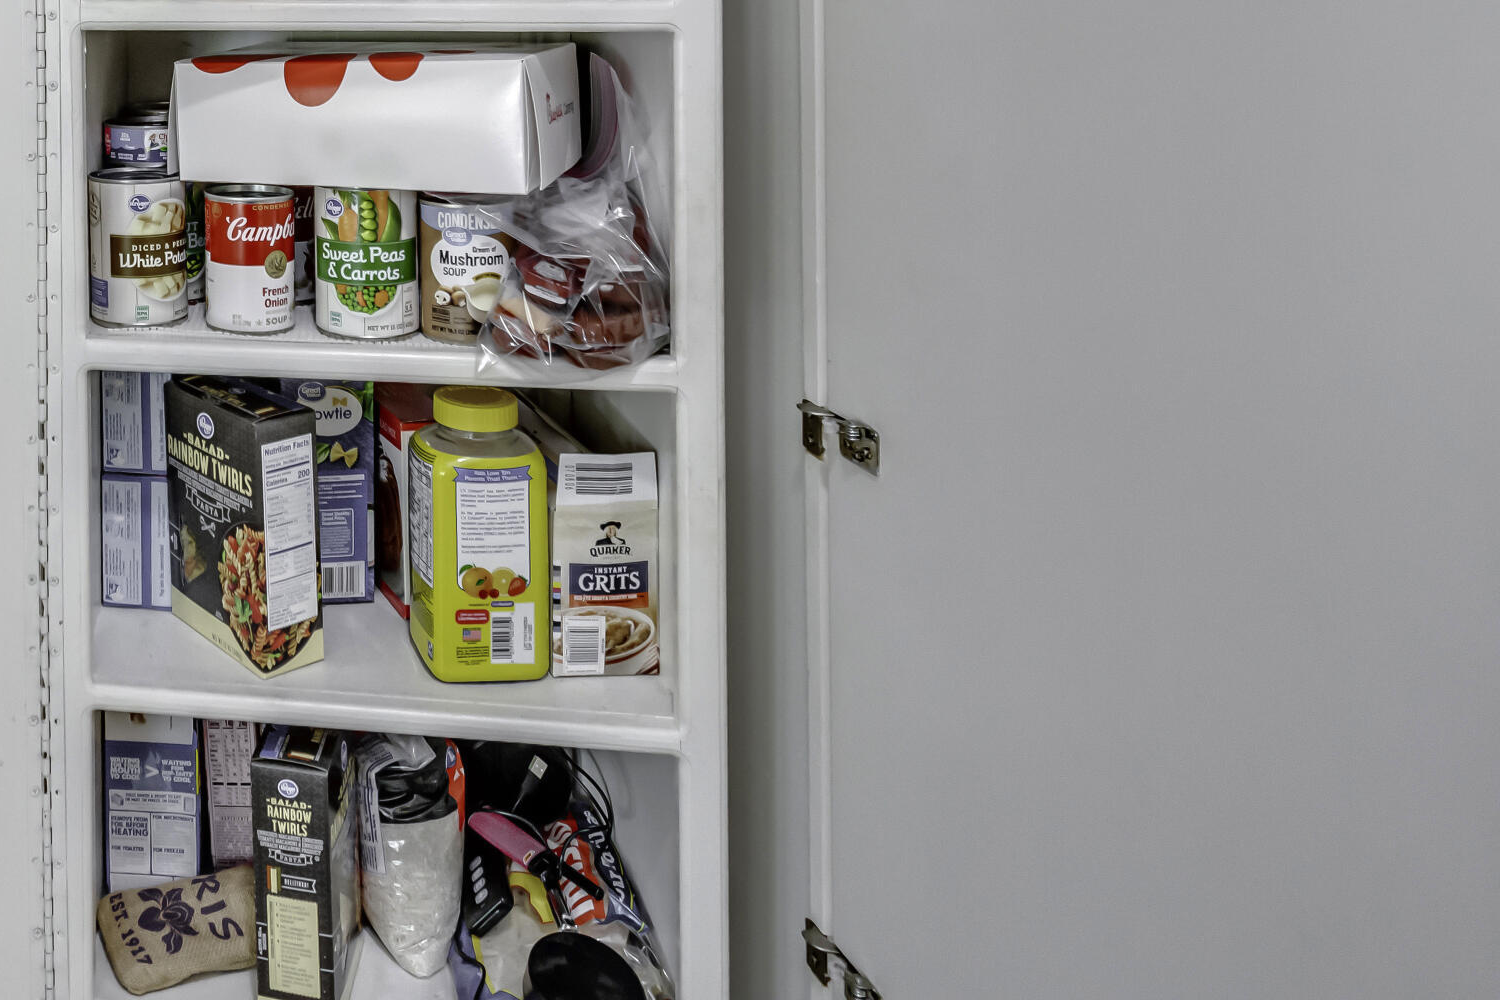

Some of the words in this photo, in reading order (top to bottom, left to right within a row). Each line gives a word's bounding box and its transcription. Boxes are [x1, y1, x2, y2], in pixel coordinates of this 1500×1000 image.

[132, 244, 161, 252] DICED
[322, 242, 367, 263] Sweet
[369, 246, 406, 263] Peas
[118, 252, 164, 268] White
[439, 249, 504, 267] Mushroom
[327, 261, 338, 278] &
[340, 263, 401, 281] Carrots
[443, 266, 467, 277] SOUP
[262, 284, 289, 297] French
[264, 296, 288, 308] Onion
[265, 315, 288, 326] SOUP
[315, 409, 352, 420] owtie
[264, 444, 292, 456] Nutrition
[293, 439, 309, 449] Facts
[167, 433, 209, 476] RAINBOW
[211, 459, 253, 497] TWIRLS
[266, 477, 288, 487] Calories
[297, 468, 310, 479] 200
[196, 498, 219, 518] PASTA
[589, 545, 631, 558] QUAKER
[594, 566, 628, 574] INSTANT
[578, 571, 641, 594] GRITS
[161, 759, 192, 767] WAITING
[121, 773, 141, 781] COOL
[270, 797, 307, 810] SALAD
[267, 804, 313, 825] RAINBOW
[111, 828, 149, 837] HEATING
[271, 819, 308, 837] TWIRLS
[279, 855, 303, 864] PASTA
[109, 892, 128, 928] EST.
[121, 928, 154, 965] 1917
